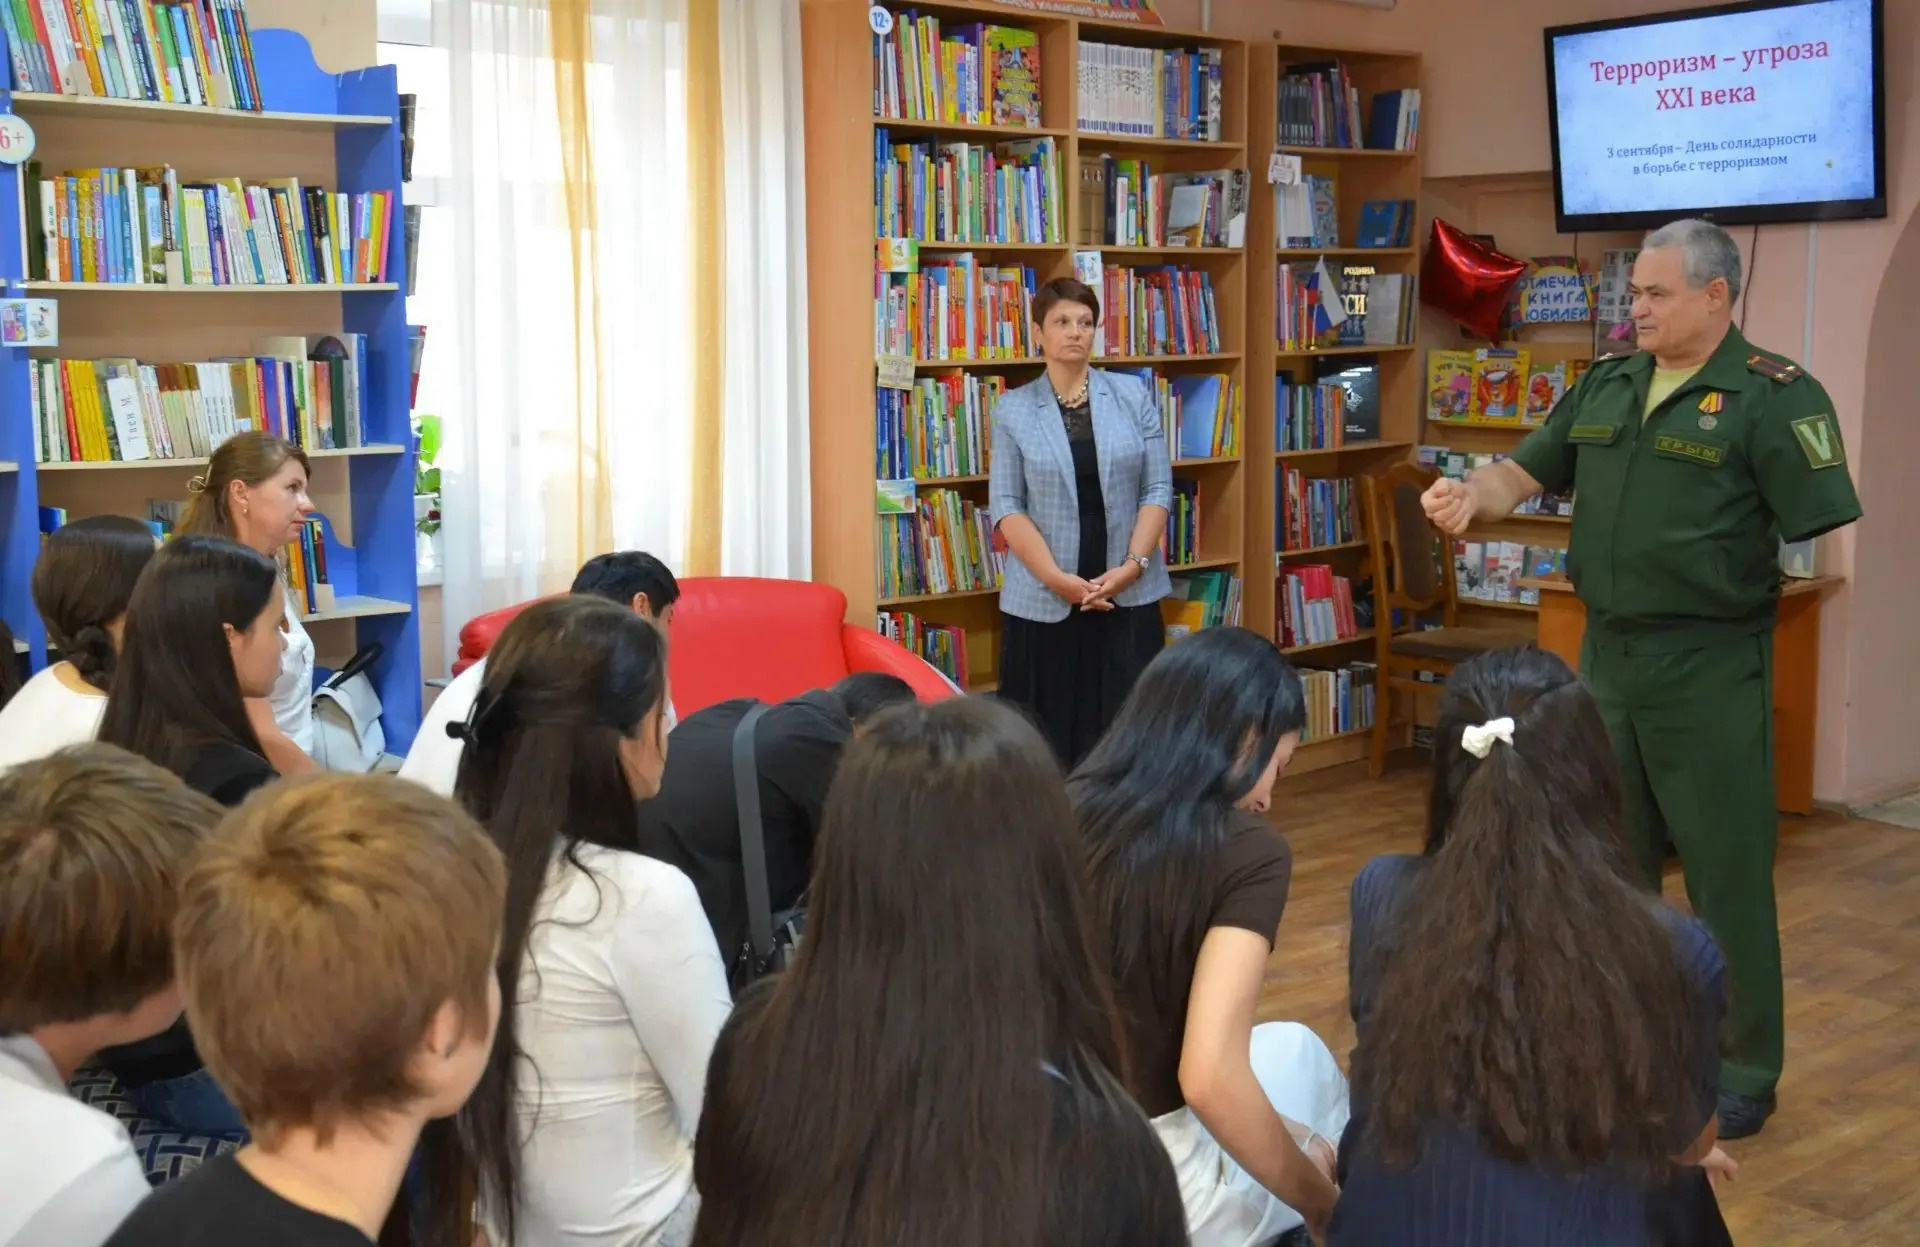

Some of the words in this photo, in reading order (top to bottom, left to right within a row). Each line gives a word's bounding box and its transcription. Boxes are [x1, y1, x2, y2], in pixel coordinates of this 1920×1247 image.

[1590, 55, 1717, 86] Терроризм
[1742, 40, 1829, 72] угроза
[1656, 86, 1694, 110] XXI
[1700, 86, 1756, 106] века
[1607, 147, 1614, 159] 3
[1616, 143, 1674, 158] сентября
[1685, 140, 1719, 154] День
[1720, 133, 1817, 150] солидарности
[1633, 165, 1640, 175] в
[1643, 160, 1686, 176] борьбе
[1688, 161, 1696, 171] с
[1698, 155, 1788, 172] терроризмом
[1527, 290, 1586, 305] КНИГА
